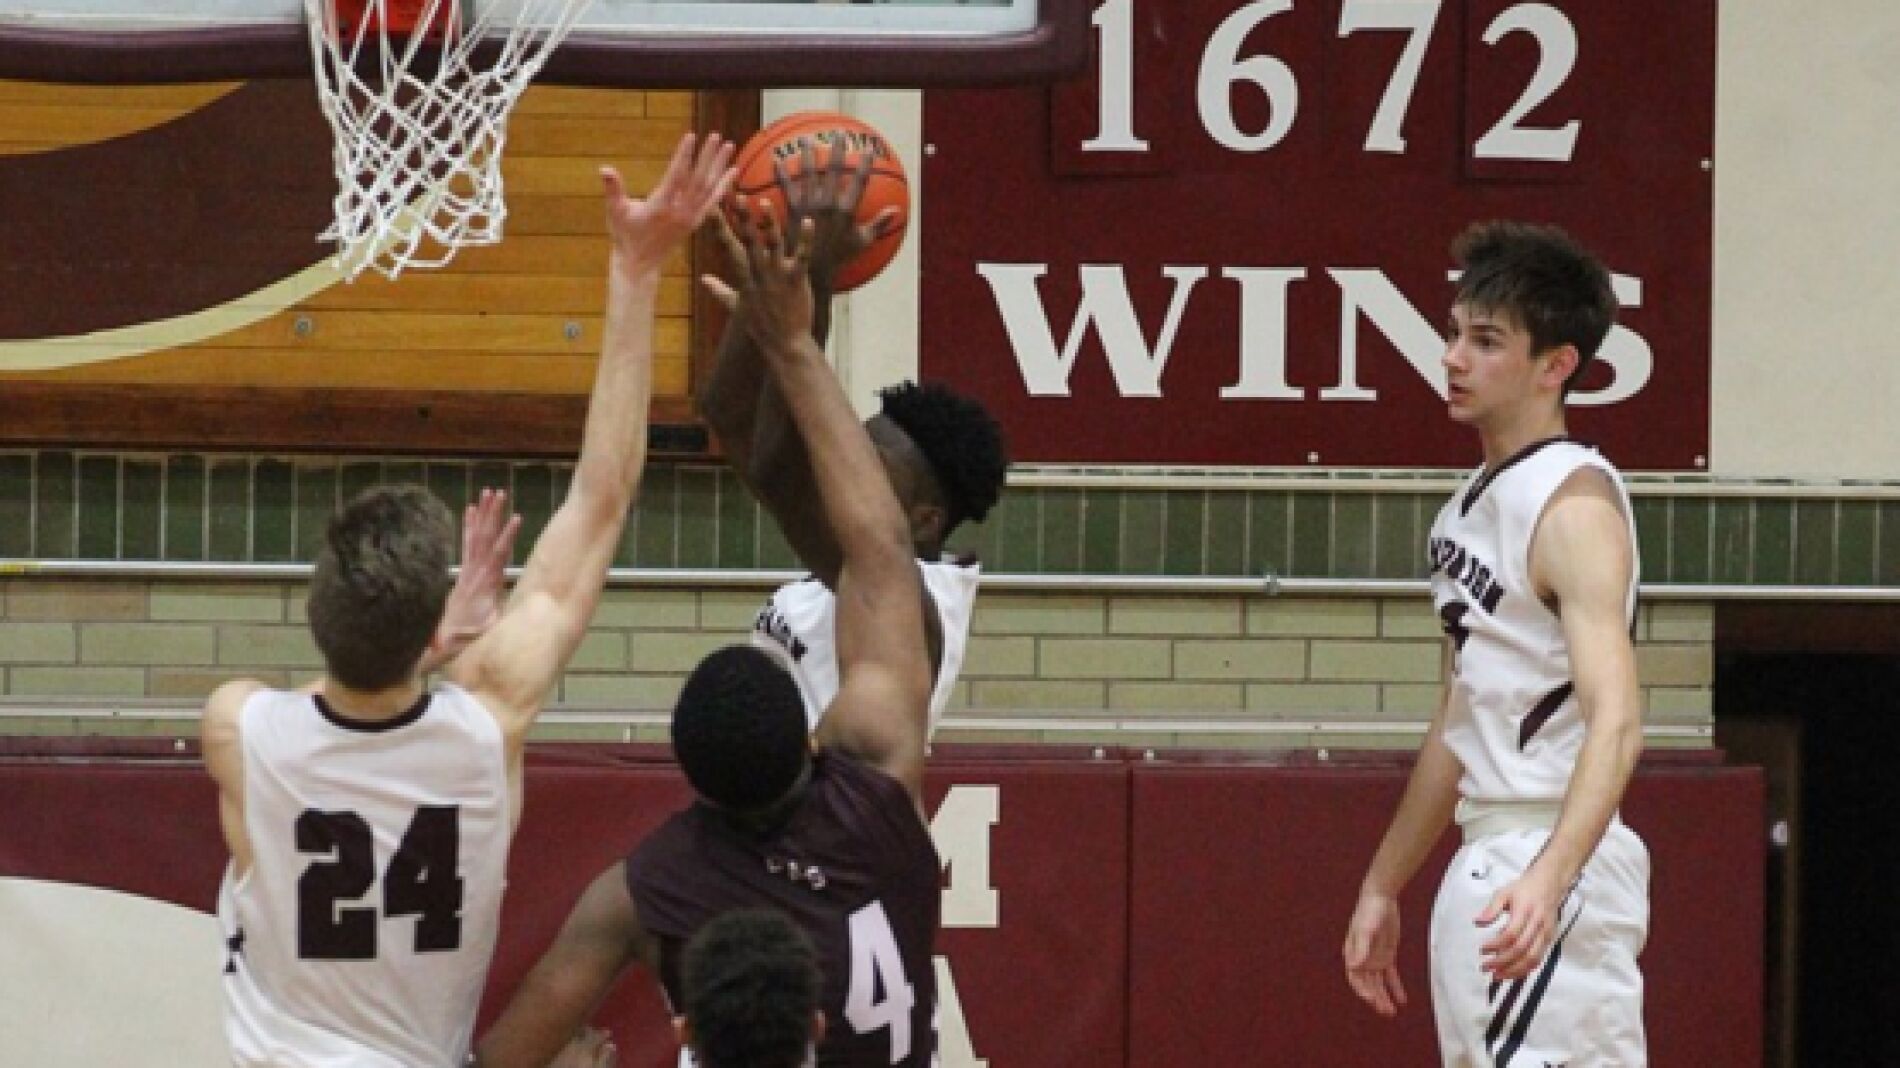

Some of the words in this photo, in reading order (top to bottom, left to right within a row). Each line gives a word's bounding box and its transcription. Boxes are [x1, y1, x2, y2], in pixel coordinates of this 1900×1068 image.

[1081, 0, 1582, 161] 1672
[295, 804, 465, 960] 24
[844, 899, 915, 1064] 4
